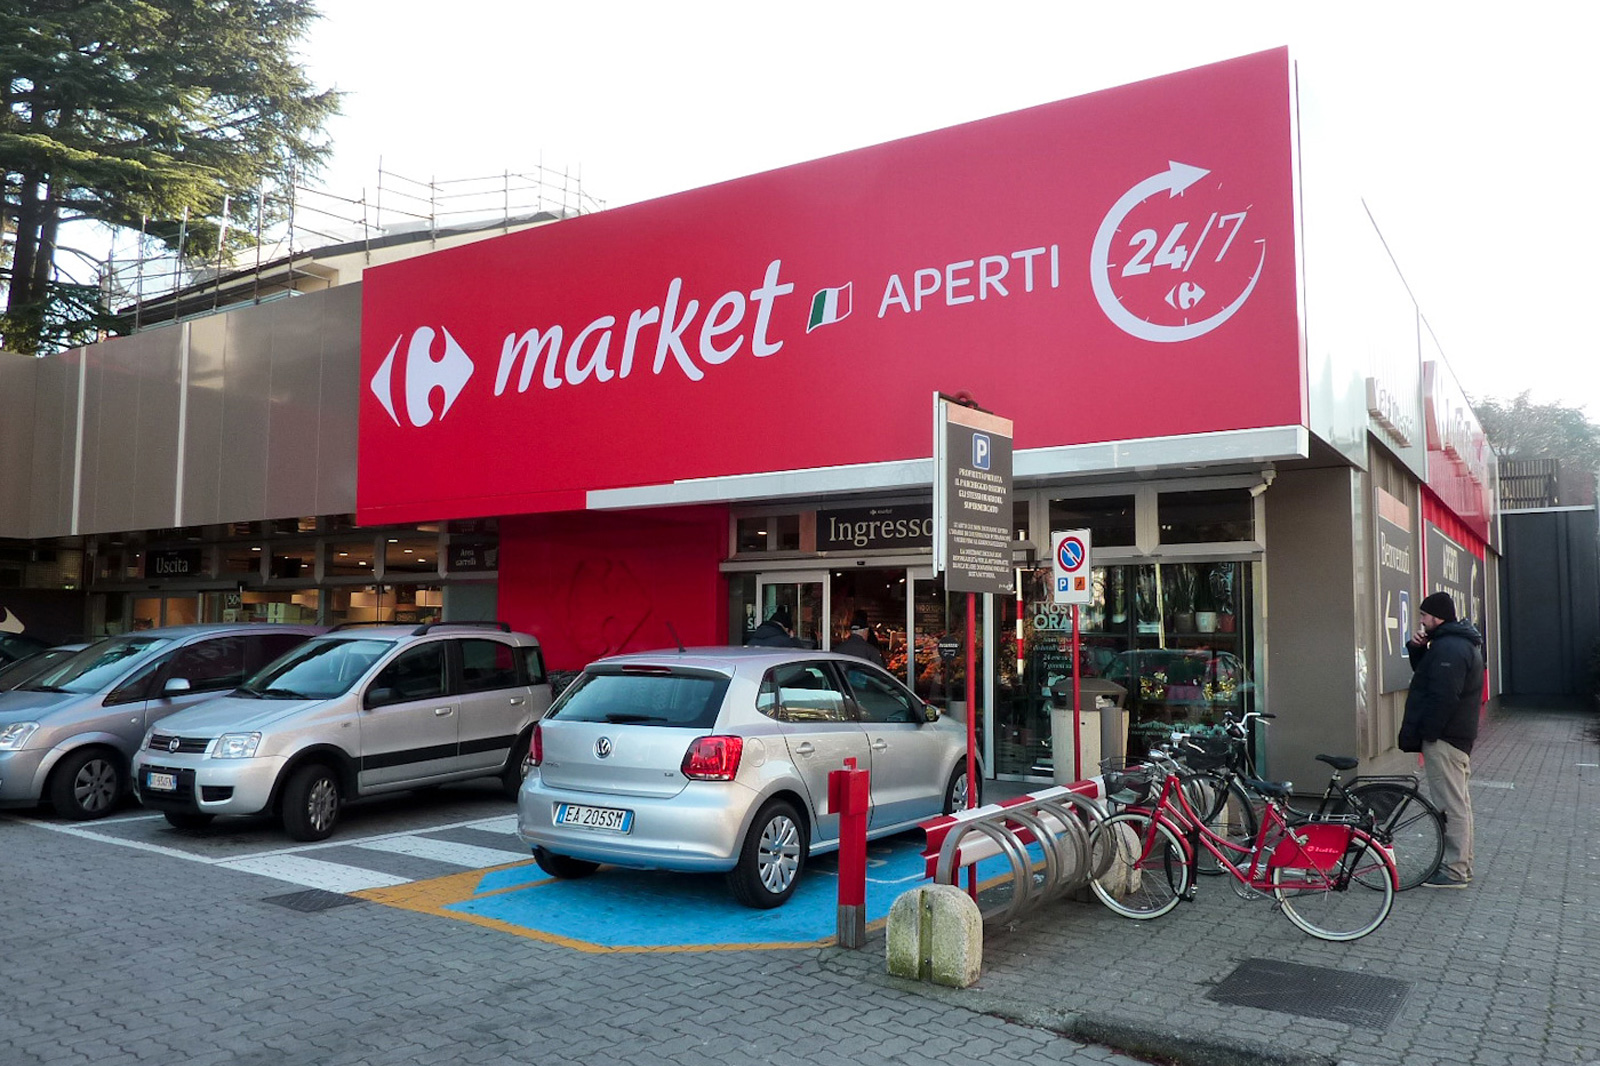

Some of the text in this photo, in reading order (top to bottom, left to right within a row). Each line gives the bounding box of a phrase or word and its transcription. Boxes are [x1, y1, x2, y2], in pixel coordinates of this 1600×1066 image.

[1122, 211, 1247, 278] 24/7
[877, 244, 1059, 319] APERTI
[494, 259, 794, 396] market
[976, 438, 988, 464] P
[829, 516, 934, 547] Ingresso
[156, 556, 189, 574] Uscita
[1060, 579, 1067, 590] P
[1033, 613, 1072, 630] ORA
[565, 806, 624, 828] EA 205SM
